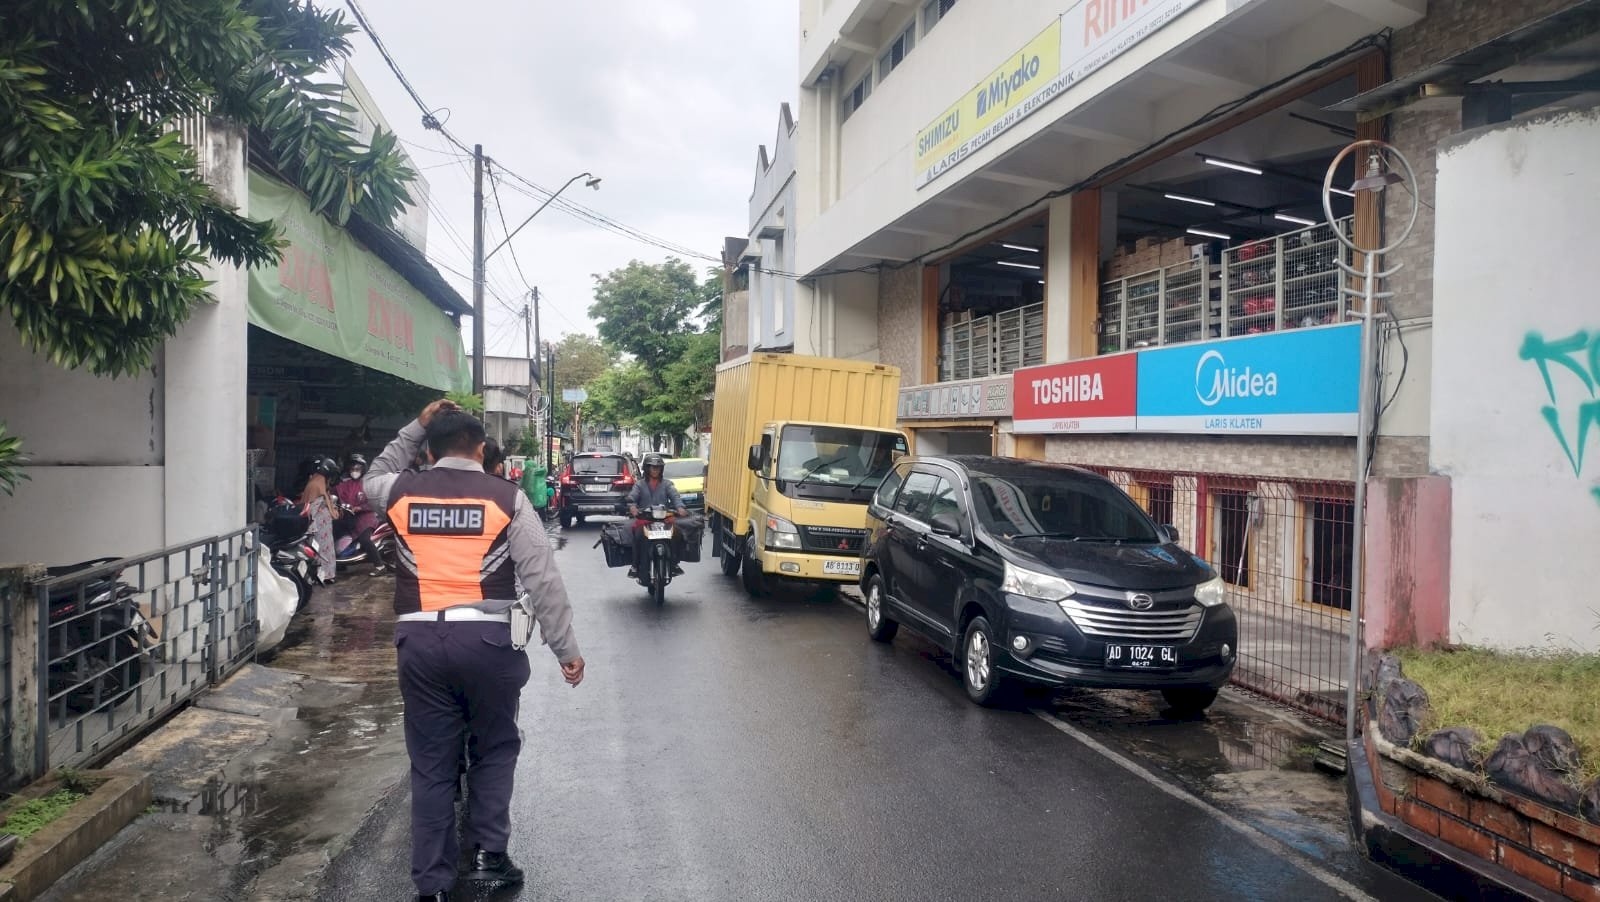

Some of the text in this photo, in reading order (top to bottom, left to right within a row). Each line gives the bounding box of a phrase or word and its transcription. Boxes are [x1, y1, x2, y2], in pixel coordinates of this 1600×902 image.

[988, 54, 1040, 111] Miyako
[918, 109, 960, 157] SHIMIZU
[932, 143, 969, 176] LARIS
[970, 129, 991, 151] PECAH
[992, 113, 1015, 135] BELAH
[1016, 109, 1023, 119] &
[1023, 70, 1075, 115] ELEKTRONIK
[1031, 373, 1104, 405] TOSHIBA
[1195, 349, 1277, 406] Midea
[1204, 417, 1263, 429] LARIS KLATEN
[409, 508, 482, 529] DISHUB
[1108, 646, 1175, 662] AD 1024 GL
